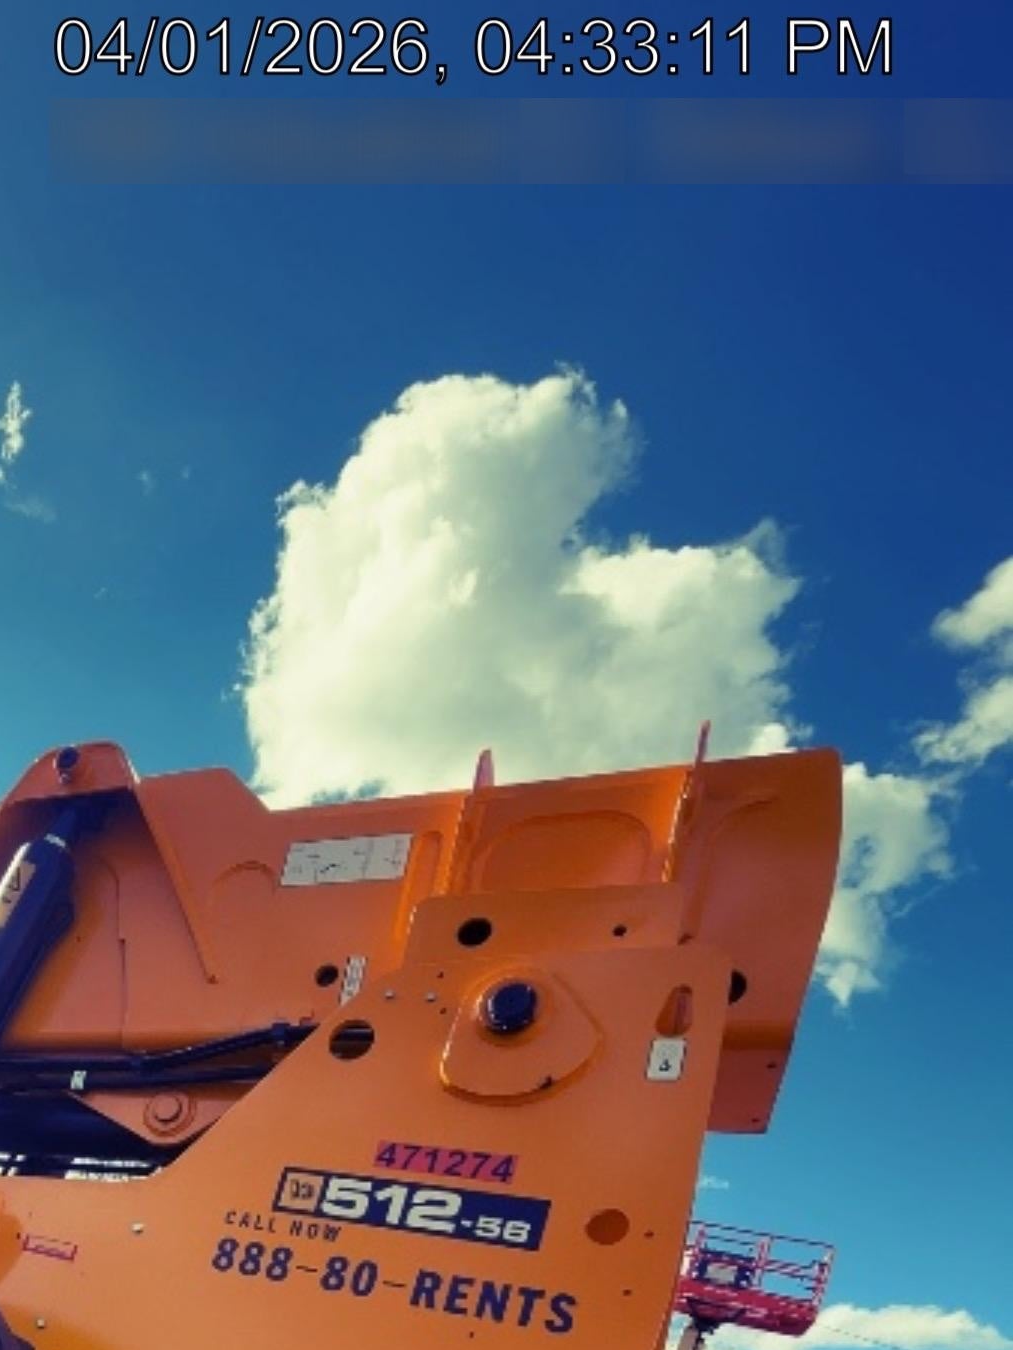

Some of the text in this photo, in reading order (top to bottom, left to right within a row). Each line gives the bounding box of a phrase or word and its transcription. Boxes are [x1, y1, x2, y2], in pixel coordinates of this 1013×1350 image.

[375, 1142, 515, 1182] 471274
[225, 1210, 342, 1243] CALL NOW
[211, 1238, 578, 1333] 888-80-RENTS
